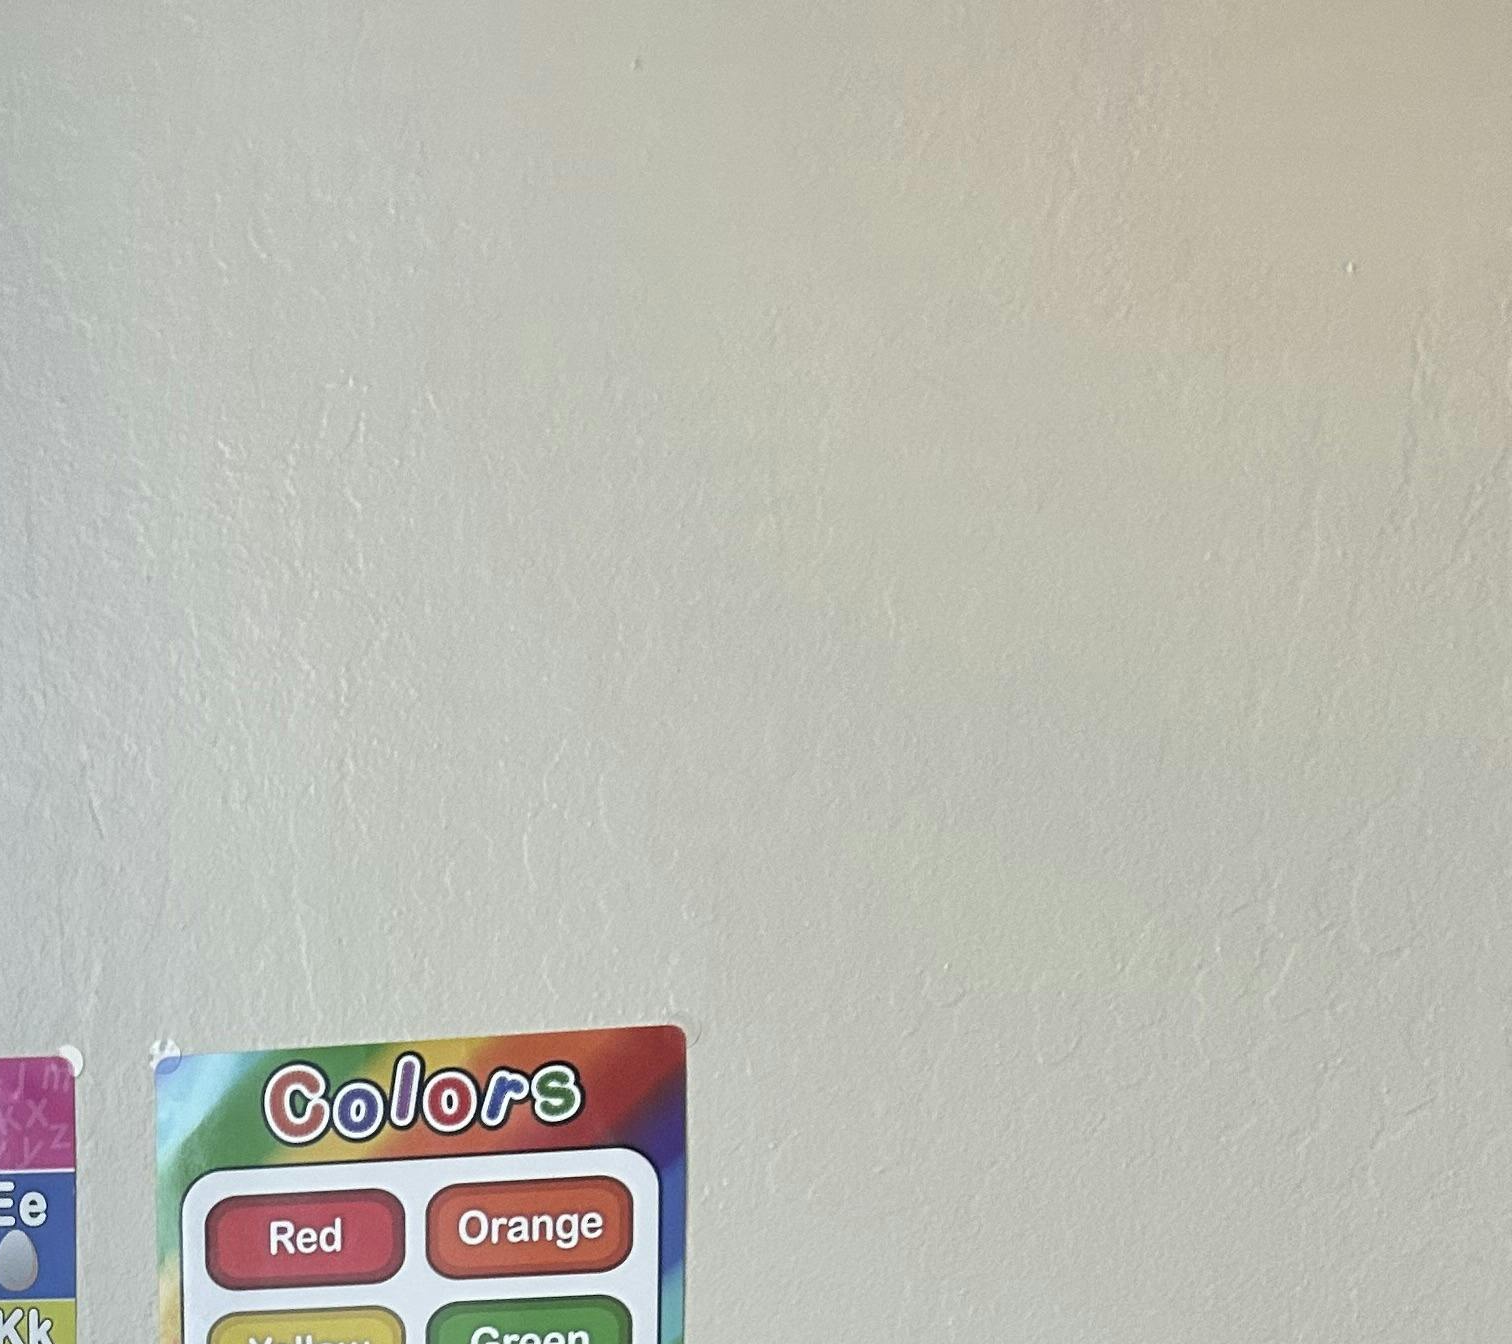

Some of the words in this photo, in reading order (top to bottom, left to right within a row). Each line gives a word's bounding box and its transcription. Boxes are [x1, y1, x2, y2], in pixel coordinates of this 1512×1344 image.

[263, 1051, 584, 1147] Colors
[268, 1216, 343, 1257] Red
[458, 1210, 604, 1250] Orange
